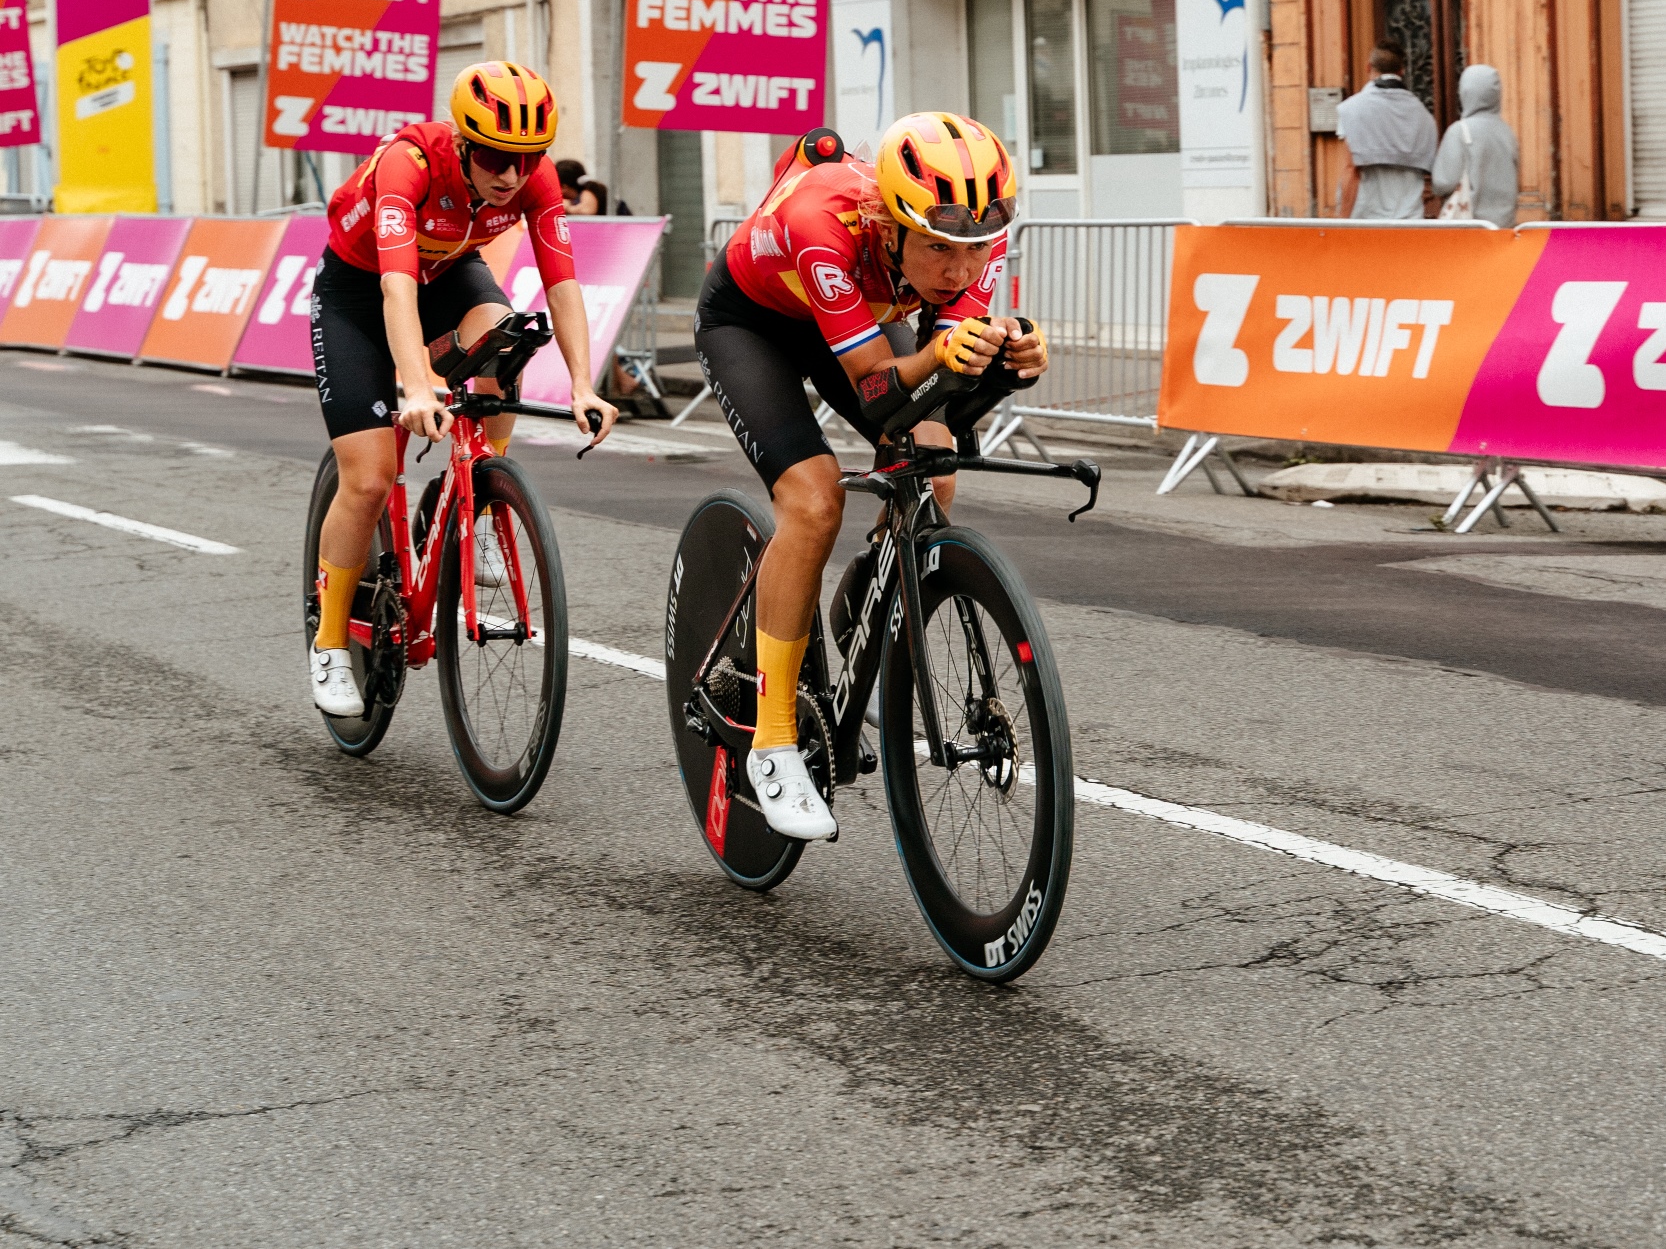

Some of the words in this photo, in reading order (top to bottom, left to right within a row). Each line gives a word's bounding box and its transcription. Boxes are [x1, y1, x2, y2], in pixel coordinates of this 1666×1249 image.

[276, 44, 430, 82] FEMMES
[279, 21, 374, 51] WATCH
[375, 29, 430, 56] THE
[691, 71, 816, 111] ZWIFT
[486, 213, 517, 228] REMA
[312, 328, 332, 404] REITAN
[1272, 294, 1455, 380] ZWIFT
[713, 380, 764, 464] REITAN
[910, 372, 939, 403] WATTSHOP
[666, 589, 678, 661] SWISS
[832, 528, 896, 726] DARE
[984, 934, 1006, 968] DT
[1007, 878, 1043, 956] SWISS
